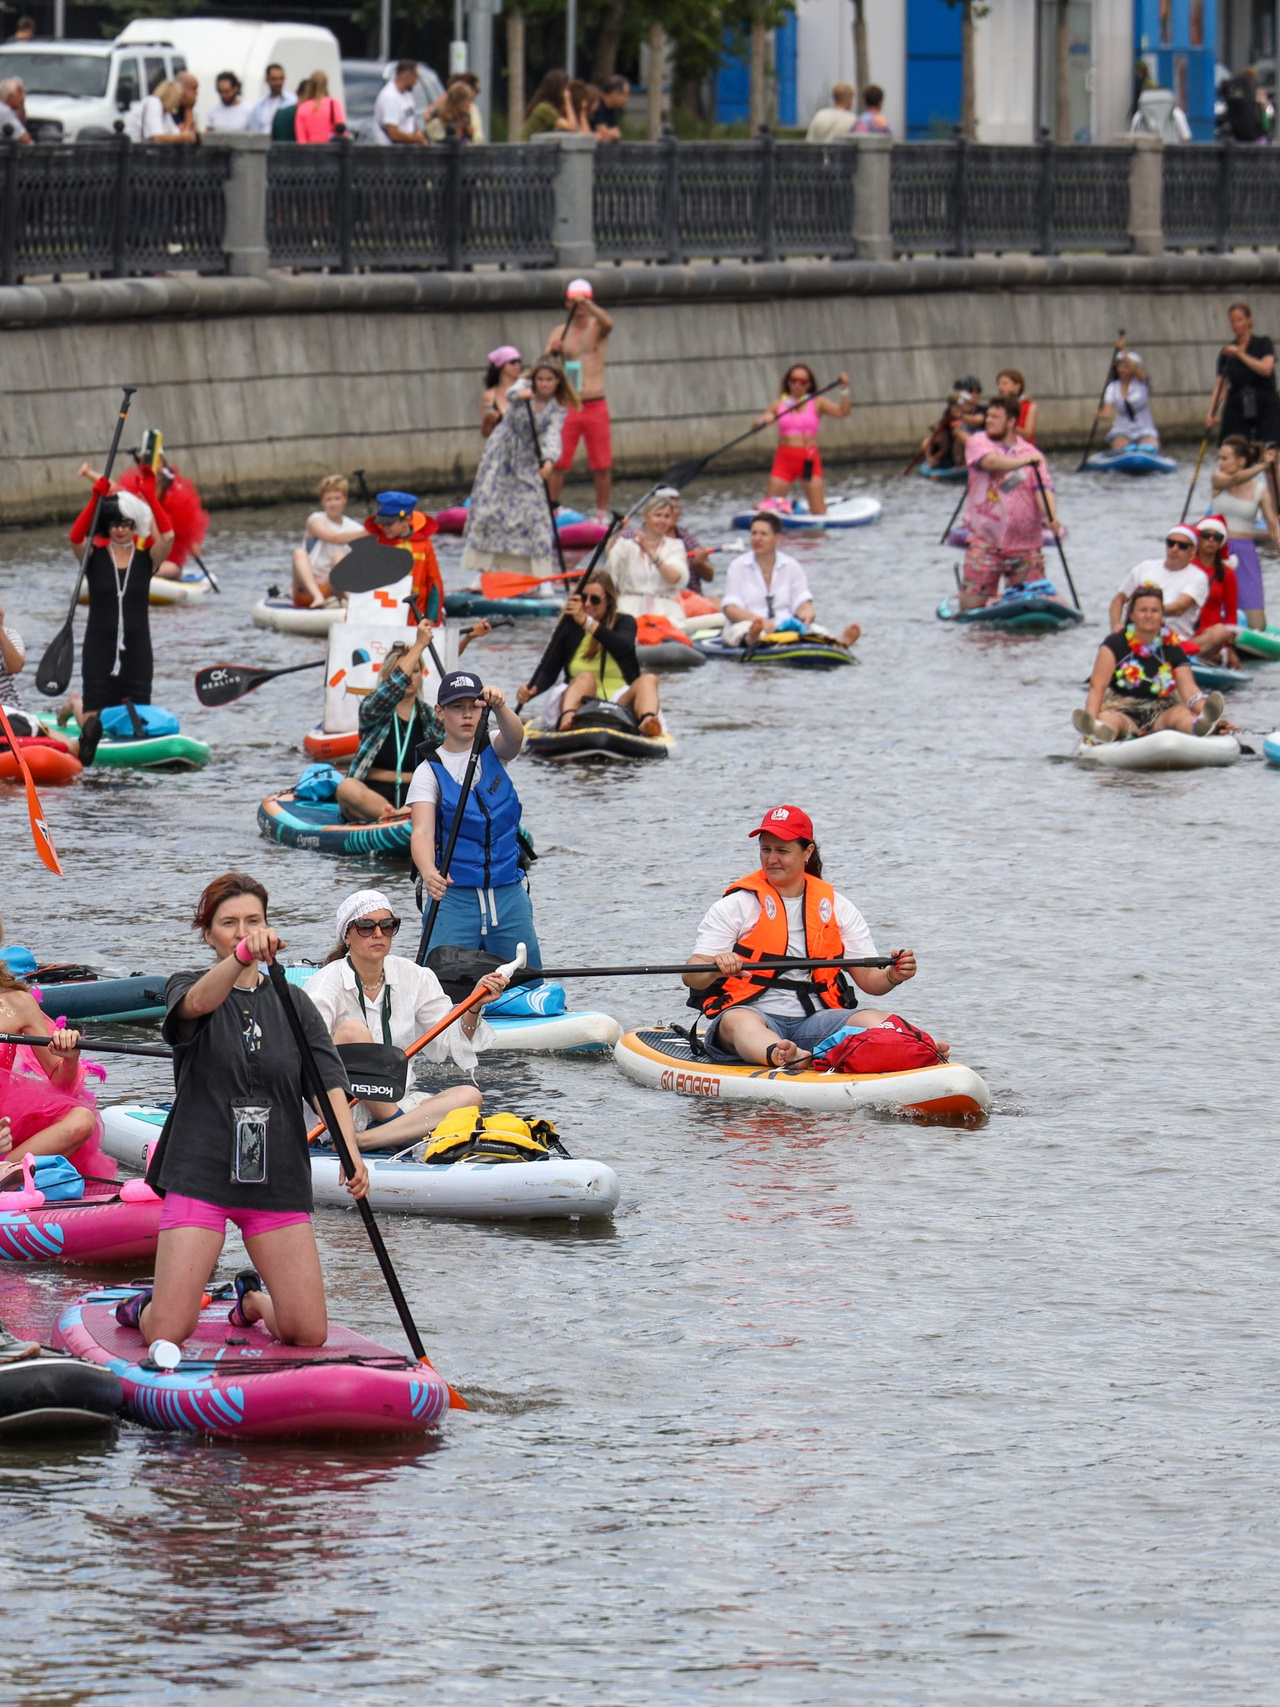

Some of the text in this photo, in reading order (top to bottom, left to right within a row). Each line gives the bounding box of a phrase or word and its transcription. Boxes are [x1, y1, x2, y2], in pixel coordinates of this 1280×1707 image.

[202, 675, 241, 690] HEALING
[350, 1083, 394, 1098] koetsu
[676, 1073, 721, 1098] BOARD
